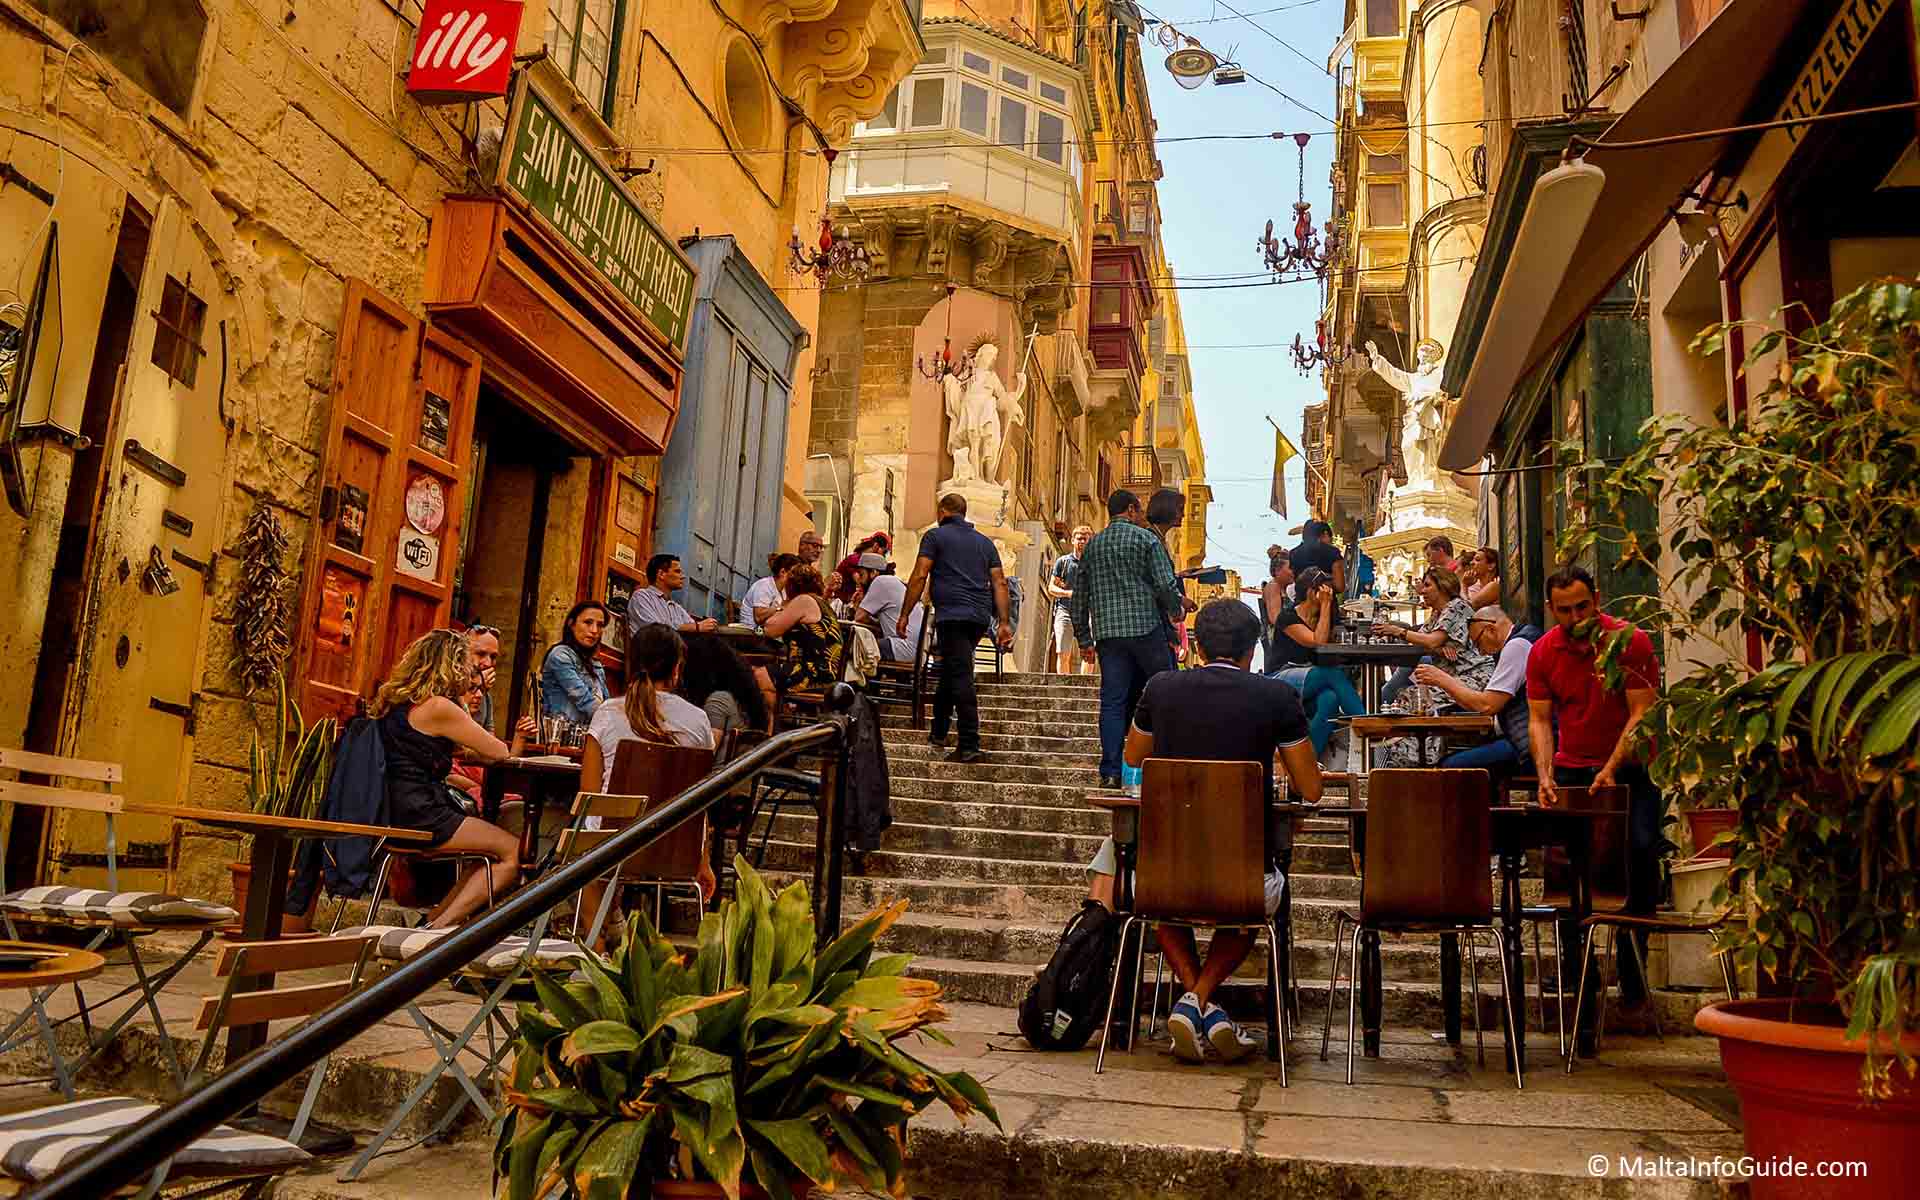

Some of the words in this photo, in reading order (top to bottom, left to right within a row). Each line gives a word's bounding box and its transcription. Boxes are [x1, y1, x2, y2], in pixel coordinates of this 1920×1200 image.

[416, 10, 508, 83] illy
[522, 103, 566, 189] SAN
[562, 144, 620, 248] PAOLO
[615, 205, 688, 318] NAUFRAGO
[553, 202, 588, 250] WINE
[591, 245, 601, 263] &
[604, 255, 654, 316] SPIRITS
